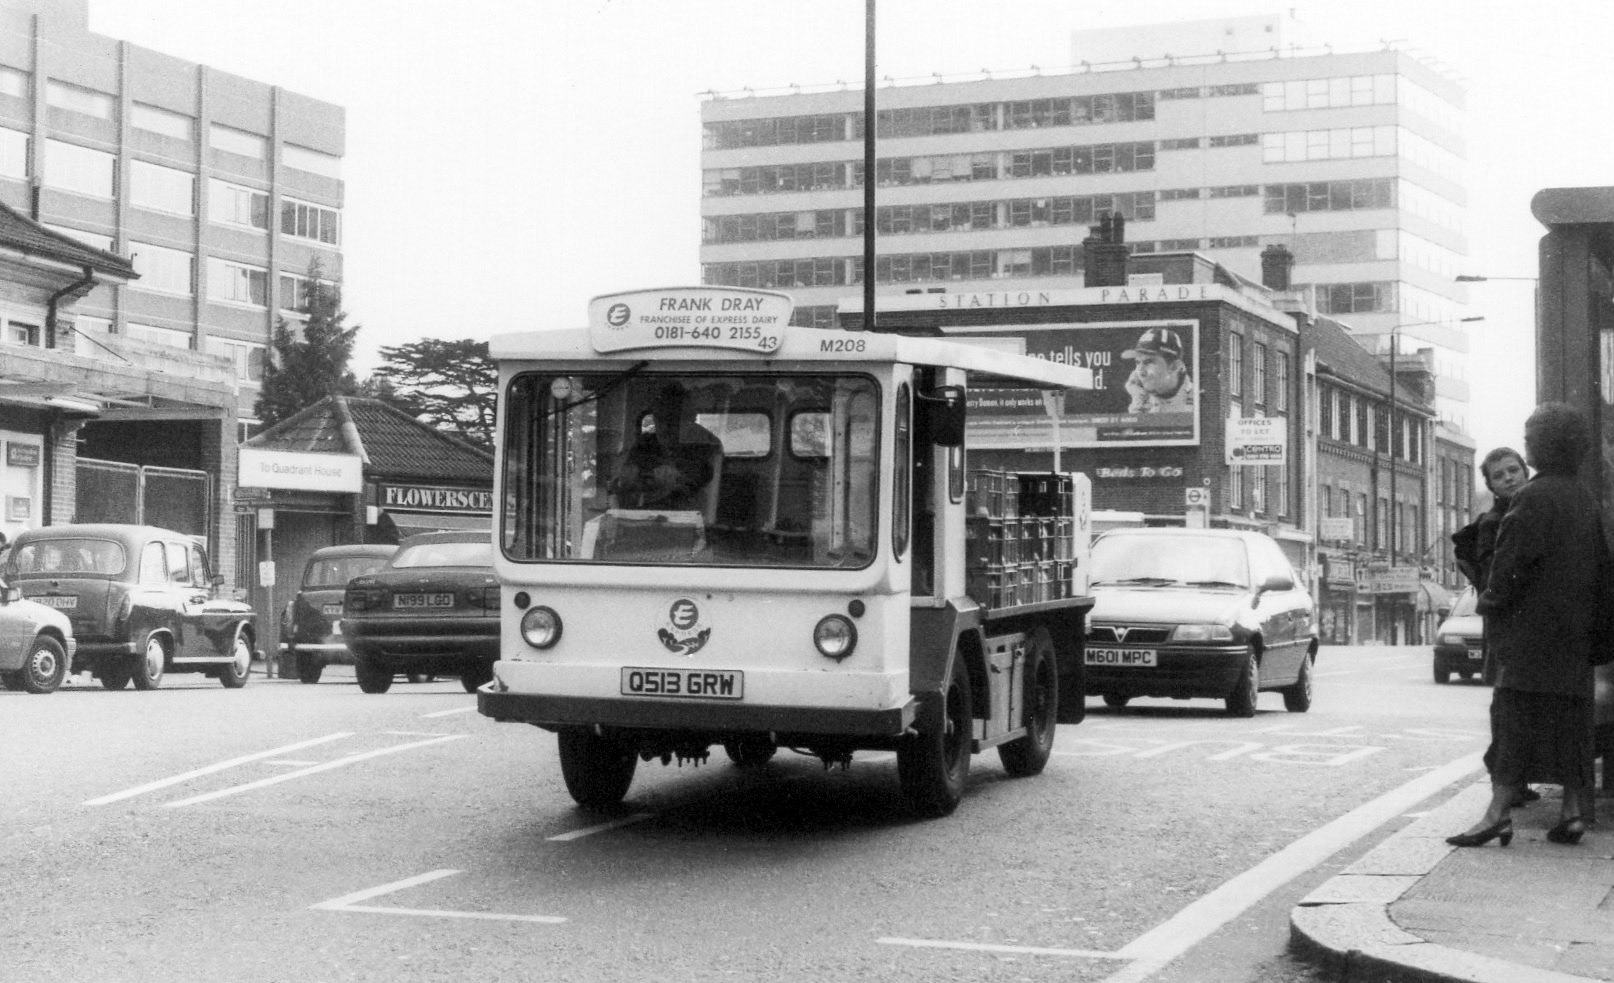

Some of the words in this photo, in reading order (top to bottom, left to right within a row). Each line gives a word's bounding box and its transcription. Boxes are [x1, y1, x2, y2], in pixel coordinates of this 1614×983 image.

[659, 297, 712, 312] FRANK
[721, 297, 765, 312] DRAY
[938, 291, 1050, 308] STATION
[1101, 286, 1207, 302] PARADE
[640, 315, 691, 324] FRANCHISEE
[695, 315, 708, 324] OF
[711, 315, 748, 324] EXPRESS
[752, 315, 778, 324] DAIRY
[654, 326, 721, 340] 0181-640
[729, 326, 761, 340] 2155
[758, 335, 778, 350] 43
[820, 339, 867, 353] M208
[1049, 345, 1081, 367] tells
[1085, 351, 1111, 370] you
[260, 462, 270, 473] To
[272, 463, 313, 475] Quadrant
[315, 465, 342, 477] House
[1086, 650, 1119, 664] M601
[1122, 650, 1151, 664] MPC
[629, 671, 681, 694] Q513
[687, 673, 735, 696] GRW
